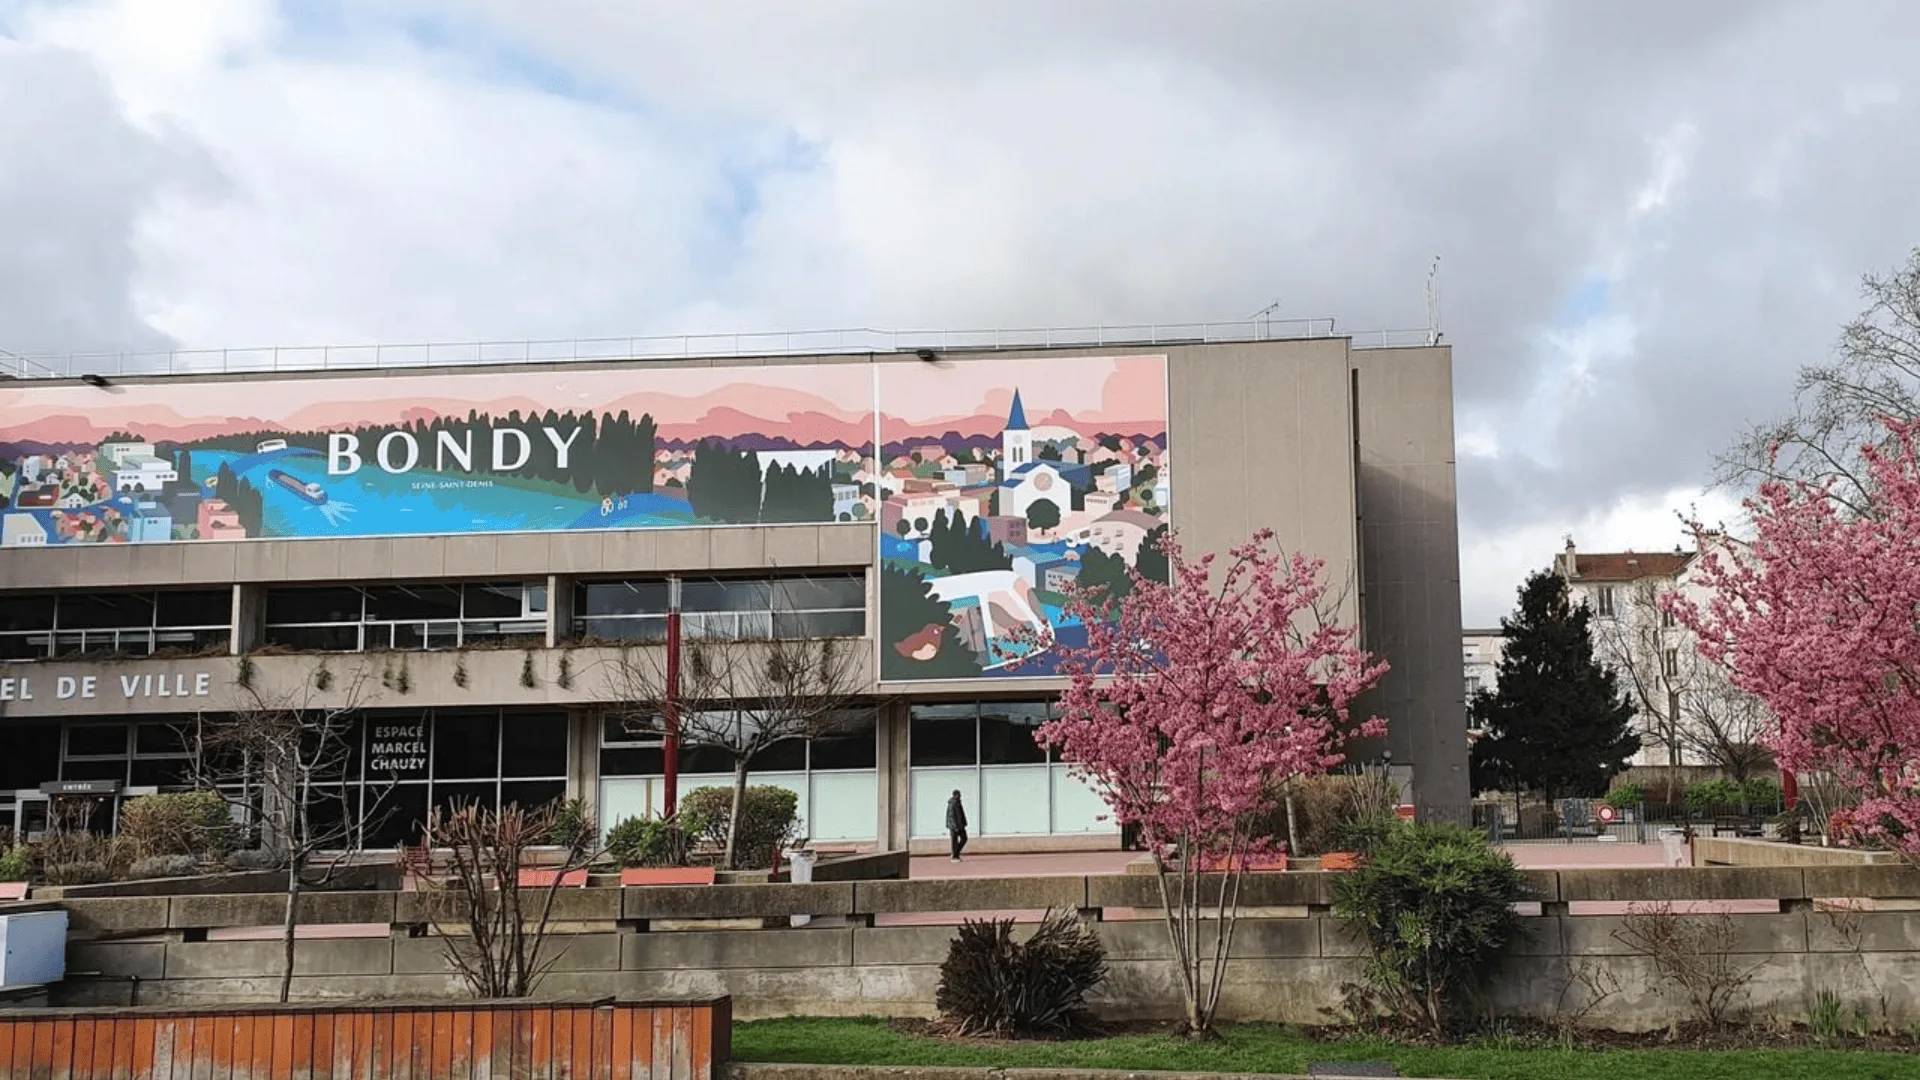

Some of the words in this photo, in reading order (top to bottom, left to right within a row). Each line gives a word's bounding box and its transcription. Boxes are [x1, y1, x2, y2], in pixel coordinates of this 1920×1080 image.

[327, 426, 582, 475] BONDY
[411, 480, 493, 490] SEINE-SAINT-DENIS
[0, 678, 33, 700] EL
[56, 676, 97, 699] DE
[120, 673, 210, 697] VILLE
[375, 726, 424, 738] ESPACE
[371, 741, 427, 754] MARCEL
[371, 758, 426, 770] CHAUZY
